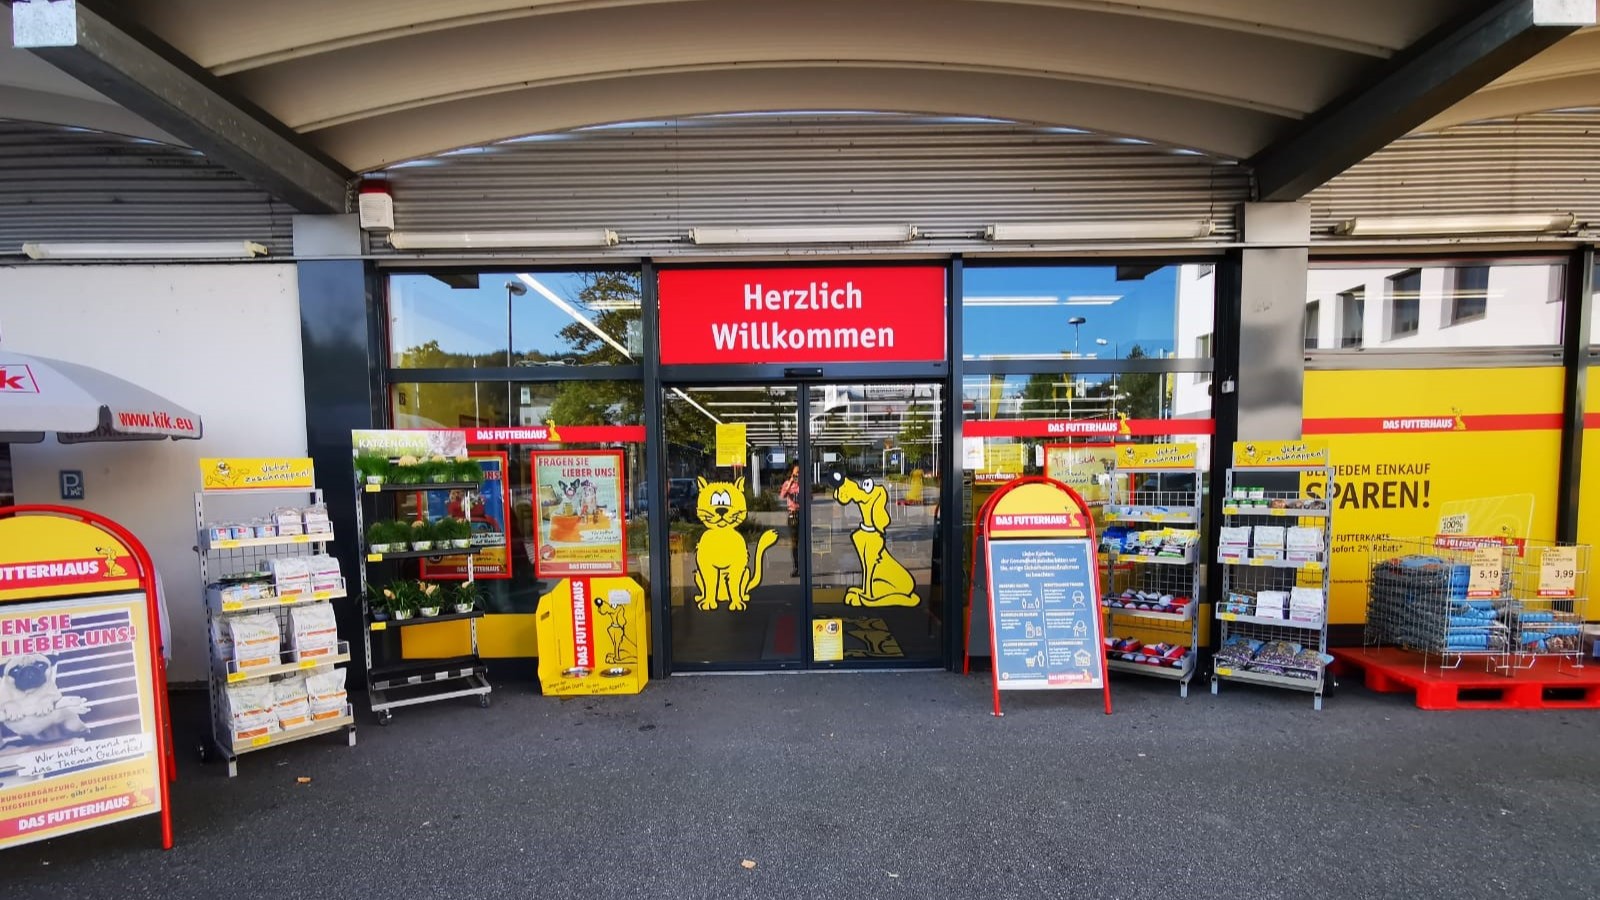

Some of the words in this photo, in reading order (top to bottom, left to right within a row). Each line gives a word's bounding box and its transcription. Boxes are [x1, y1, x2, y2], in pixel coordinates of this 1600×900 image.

[744, 281, 862, 310] Herzlich
[711, 322, 894, 350] Willkommen
[118, 411, 194, 431] www.kik.eu
[1048, 423, 1064, 433] DAS
[1065, 422, 1118, 433] FUTTERHAUS
[1383, 420, 1399, 430] DAS
[1400, 418, 1453, 430] FUTTERHAUS
[477, 430, 494, 440] DAS
[495, 429, 547, 440] FUTTERHAUS
[538, 457, 573, 467] FRAGEN
[576, 457, 589, 466] SIE
[1333, 464, 1371, 476] JEDEM
[1376, 463, 1431, 475] EINKAUF
[562, 468, 592, 477] LIEBER
[595, 467, 616, 477] UNS!
[63, 473, 80, 494] P
[996, 515, 1012, 525] DAS
[1013, 514, 1067, 525] FUTTERHAUS
[1336, 533, 1391, 542] FUTTERKARTE
[1332, 544, 1355, 553] sofort
[1358, 544, 1369, 552] 2%
[572, 581, 587, 644] FUTTERHAUS
[37, 614, 71, 631] SIE
[1, 633, 80, 656] LIEBER
[85, 625, 137, 646] UNS!
[577, 645, 589, 665] DAS
[31, 764, 52, 775] das
[57, 756, 94, 769] Thema
[96, 741, 143, 760] Gelenke!
[35, 752, 53, 763] Wir
[57, 743, 92, 759] helfen
[96, 738, 120, 751] rund
[18, 815, 45, 832] DAS
[47, 796, 130, 825] FUTTERHAUS
